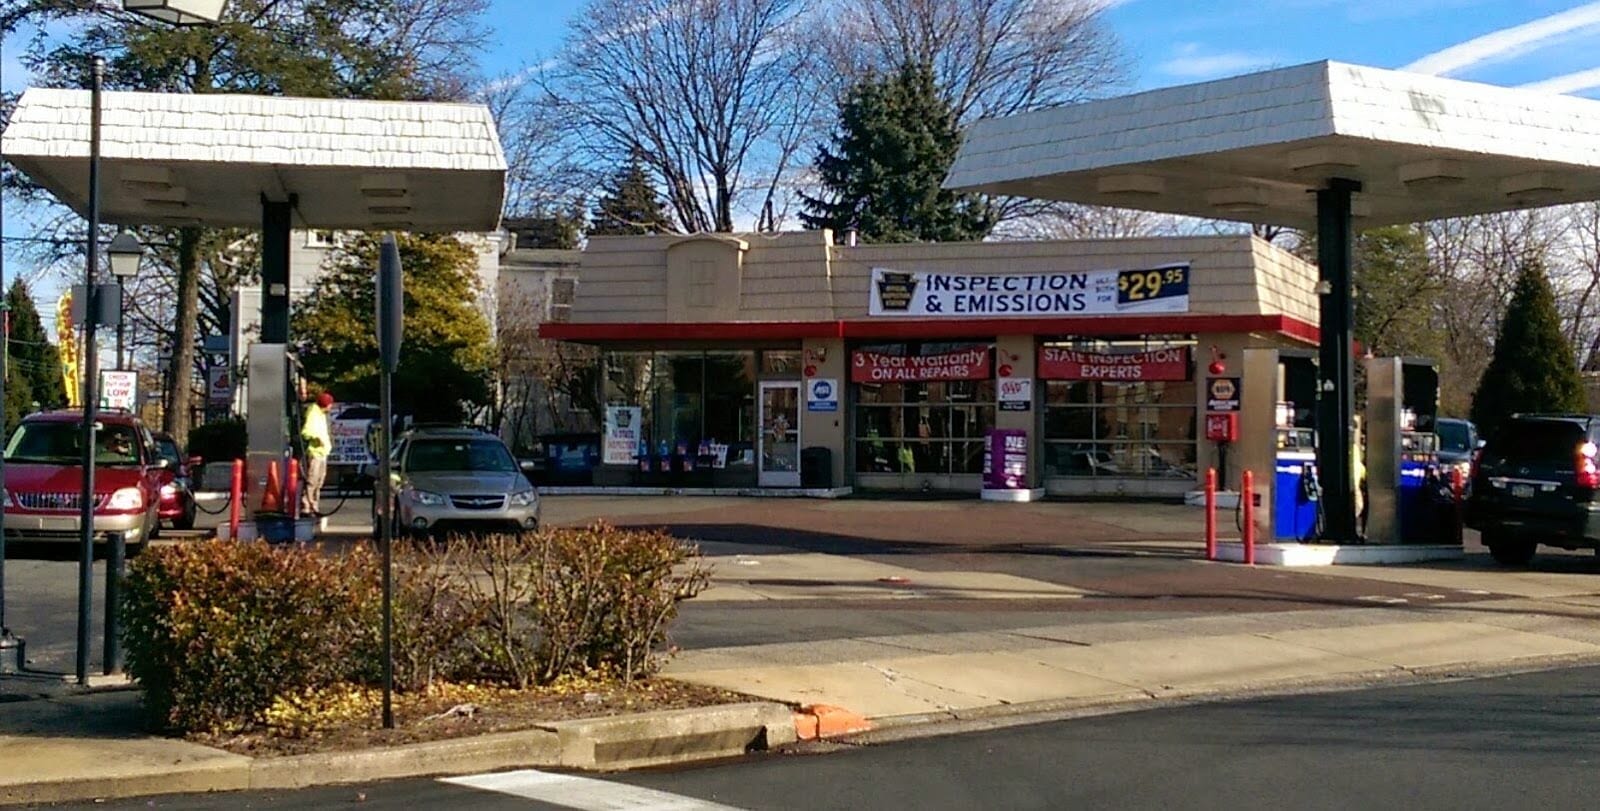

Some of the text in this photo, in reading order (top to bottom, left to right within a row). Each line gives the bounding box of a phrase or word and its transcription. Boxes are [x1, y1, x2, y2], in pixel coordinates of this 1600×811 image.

[926, 274, 1088, 291] INSPECTION
[1119, 268, 1184, 299] $29.95
[925, 294, 1086, 312] & EMISSIONS
[855, 353, 865, 367] 3
[869, 353, 906, 367] Year
[1044, 350, 1181, 364] STATE INSPECTION
[871, 365, 969, 379] ON ALL REPAIRS
[1081, 365, 1141, 378] EXPERTS
